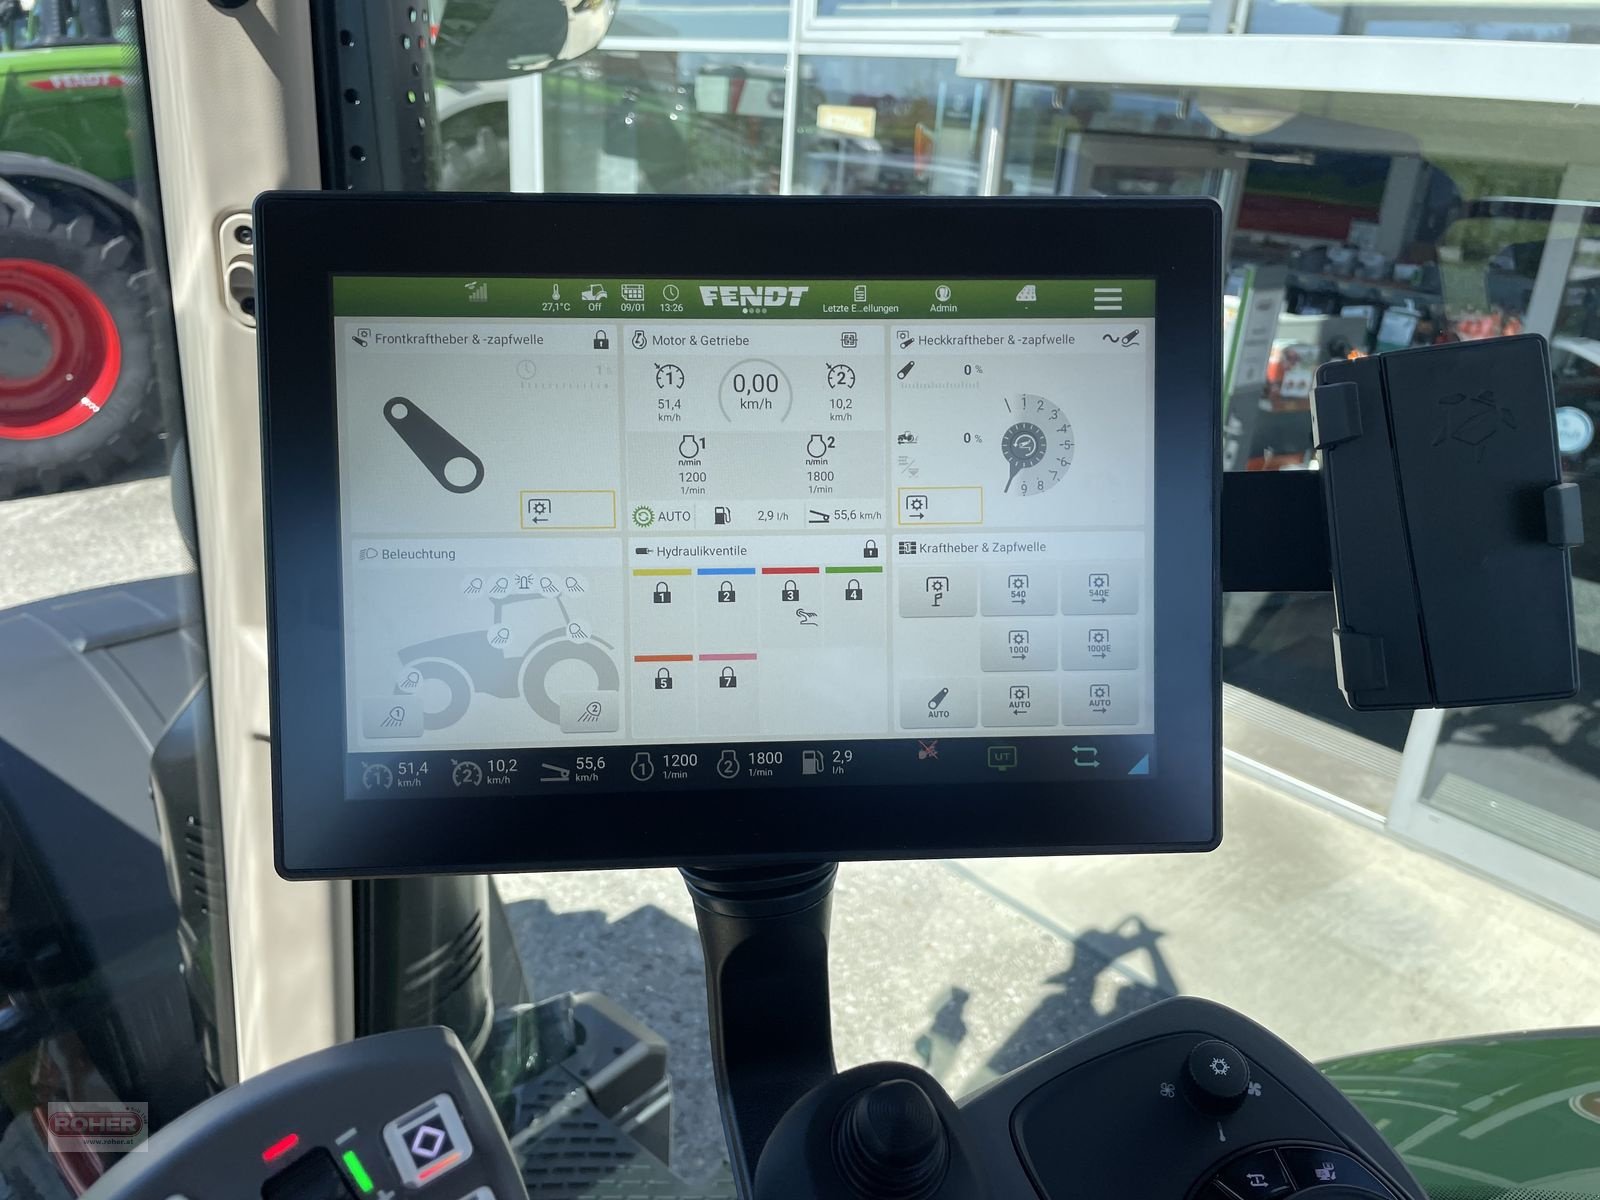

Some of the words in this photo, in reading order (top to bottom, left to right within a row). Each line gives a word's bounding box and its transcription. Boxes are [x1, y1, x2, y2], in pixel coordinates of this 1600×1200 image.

[51, 71, 111, 88] FENDT
[699, 286, 809, 306] FENDT
[542, 302, 571, 312] 27,1°C
[588, 302, 602, 312] Off
[620, 302, 645, 312] 09/01
[660, 303, 684, 312] 13:26
[822, 304, 849, 313] Letzte
[930, 303, 958, 312] Admin
[375, 333, 468, 345] Frontkraftheber
[472, 333, 481, 345] &
[483, 333, 544, 347] -zapfwelle
[652, 335, 687, 346] Motor
[689, 335, 698, 346] &
[700, 335, 750, 346] Getriebe
[918, 334, 1005, 346] Heckkraftheber
[1007, 335, 1017, 346] &
[1017, 334, 1075, 347] -zapfwelle
[964, 364, 972, 376] 0
[975, 364, 983, 374] %
[666, 372, 673, 385] 1
[837, 371, 846, 385] 2
[733, 374, 779, 396] 0,00
[658, 399, 682, 411] 51,4
[740, 398, 772, 410] km/h
[830, 398, 853, 410] 10,2
[658, 413, 681, 422] km/h
[829, 413, 852, 422] km/h
[699, 437, 706, 449] 1
[827, 436, 836, 449] 2
[963, 432, 971, 443] 0
[974, 434, 983, 444] %
[678, 459, 701, 467] n/min
[805, 458, 828, 466] n/min
[679, 472, 707, 482] 1200
[807, 471, 835, 482] 1800
[681, 486, 706, 495] 1/min
[808, 485, 833, 494] 1/min
[658, 511, 691, 522] AUTO
[757, 510, 774, 522] 2,9
[777, 512, 789, 521] l/h
[834, 510, 857, 522] 55,6
[859, 511, 882, 520] km/h
[657, 546, 748, 559] Hydraulikventile
[919, 543, 979, 554] Kraftheber
[981, 543, 989, 553] &
[992, 542, 1047, 555] Zapfwelle
[382, 548, 456, 562] Beleuchtung
[659, 593, 665, 602] 1
[723, 592, 730, 602] 2
[787, 591, 794, 601] 3
[850, 590, 858, 599] 4
[1010, 590, 1026, 599] 540
[1088, 589, 1110, 597] 540E
[1009, 646, 1029, 654] 1000
[1087, 645, 1111, 653] 1000E
[660, 679, 667, 689] 5
[724, 678, 731, 687] 7
[1008, 701, 1031, 709] AUTO
[1089, 699, 1111, 707] AUTO
[928, 710, 950, 718] AUTO
[663, 753, 698, 767] 1200
[749, 751, 783, 765] 1800
[832, 750, 853, 764] 2,9
[994, 752, 1011, 761] UT
[398, 761, 429, 776] 51,4
[487, 758, 518, 773] 10,2
[575, 756, 606, 771] 55,6
[723, 760, 734, 773] 2
[638, 763, 646, 776] 1
[663, 770, 688, 779] 1/min
[749, 768, 773, 777] 1/min
[832, 766, 844, 775] l/h
[374, 772, 382, 785] 1
[462, 769, 473, 783] 2
[487, 775, 511, 785] km/h
[575, 773, 599, 782] km/h
[397, 777, 422, 788] km/h
